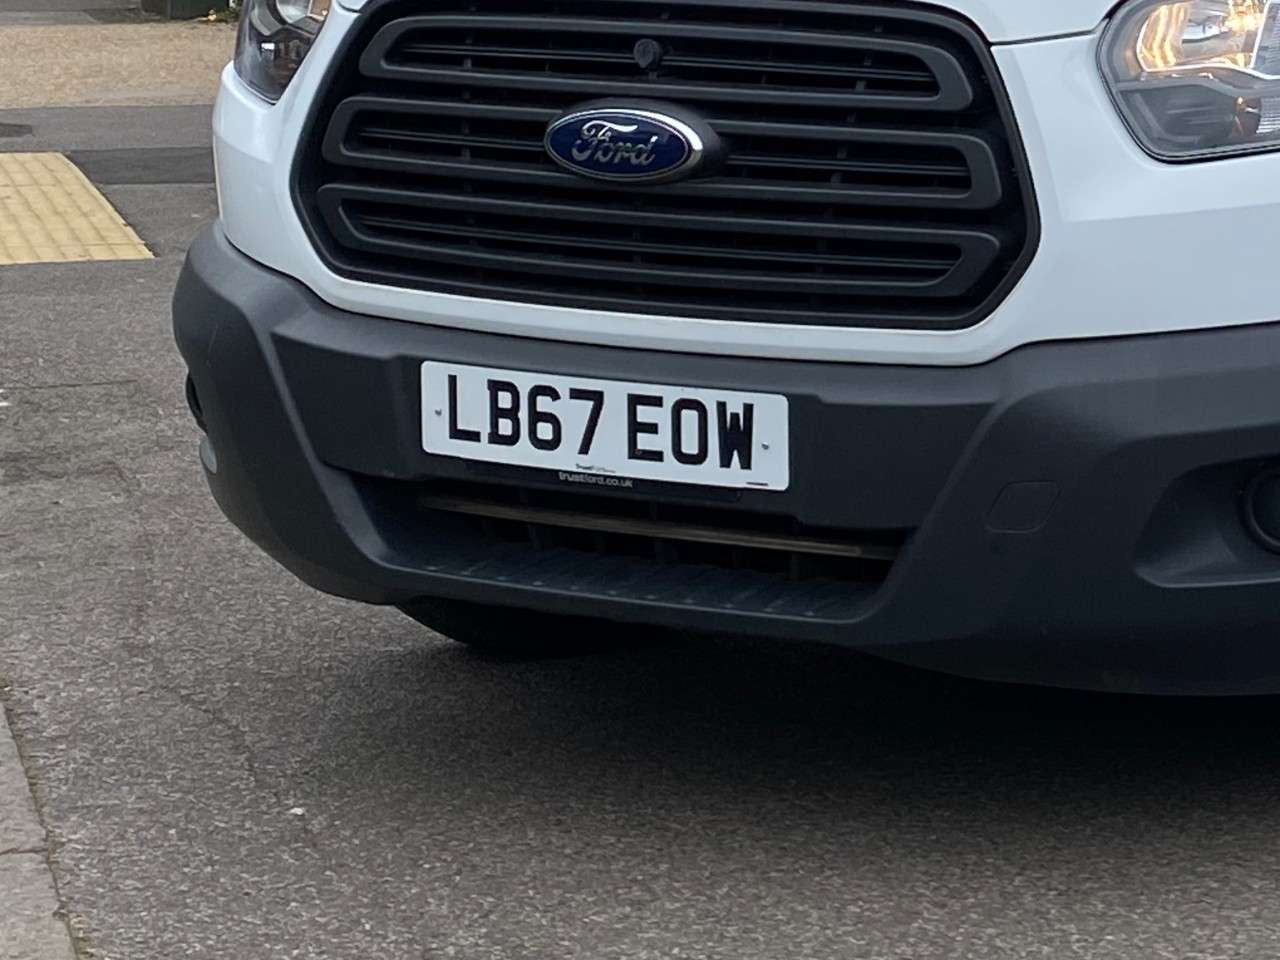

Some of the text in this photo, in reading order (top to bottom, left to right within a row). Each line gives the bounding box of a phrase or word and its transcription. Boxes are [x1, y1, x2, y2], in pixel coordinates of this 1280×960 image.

[571, 120, 658, 166] Ford
[447, 374, 754, 471] LB67 EOW
[558, 471, 633, 488] trustford.co.uk
